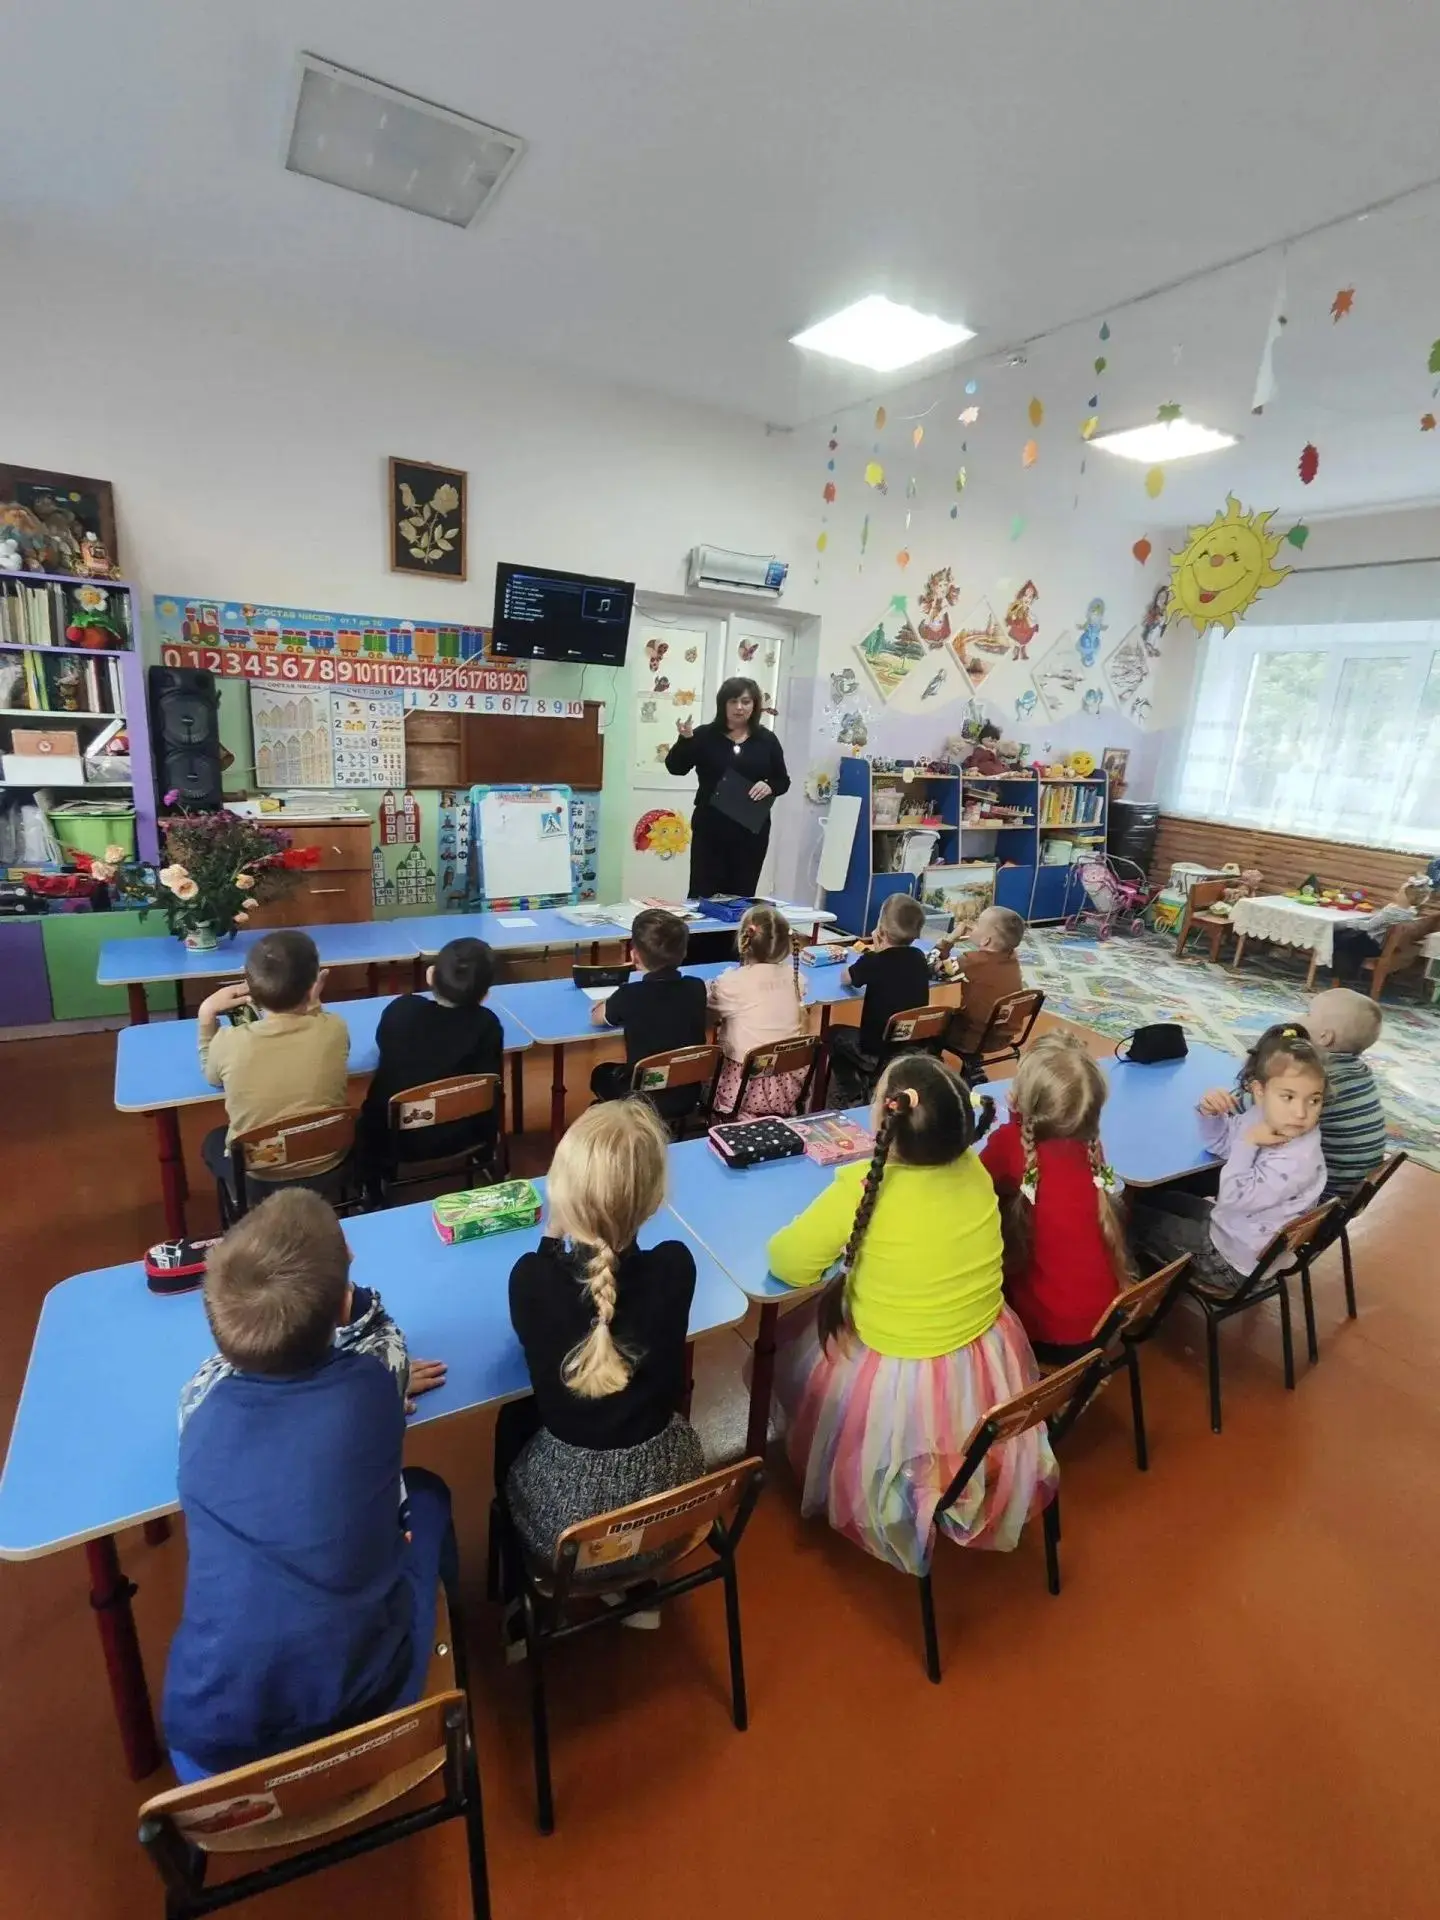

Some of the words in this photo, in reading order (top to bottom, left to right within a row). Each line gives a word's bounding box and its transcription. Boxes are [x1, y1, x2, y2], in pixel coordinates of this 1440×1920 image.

[164, 650, 181, 667] 0
[188, 651, 199, 668] 1
[206, 652, 221, 673] 2
[226, 652, 241, 674] 3
[245, 655, 261, 676] 4
[266, 656, 279, 676] 5
[282, 658, 298, 678] 6
[301, 659, 315, 678] 7
[320, 660, 334, 680] 8
[338, 661, 352, 681] 9
[354, 662, 371, 682] 10
[372, 664, 388, 684] 11
[388, 665, 405, 684] 12
[404, 666, 421, 685] 13
[421, 668, 438, 686] 14
[438, 668, 453, 687] 15
[454, 669, 468, 688] 16
[468, 670, 482, 688] 17
[483, 672, 498, 690] 18
[498, 672, 512, 690] 19
[513, 674, 527, 692] 20
[334, 701, 339, 710] 1
[369, 703, 376, 711] 6
[411, 692, 417, 706] 1
[430, 692, 439, 706] 2
[448, 694, 458, 708] 3
[465, 695, 476, 709] 4
[484, 696, 494, 710] 5
[502, 698, 511, 710] 6
[520, 699, 528, 712] 7
[537, 700, 546, 713] 8
[554, 700, 562, 714] 9
[568, 702, 582, 714] 10
[335, 720, 342, 728] 2
[370, 720, 377, 728] 7
[336, 737, 342, 746] 3
[371, 738, 378, 746] 8
[336, 754, 344, 762] 4
[372, 755, 378, 764] 9
[338, 772, 344, 780] 5
[372, 772, 384, 781] 10
